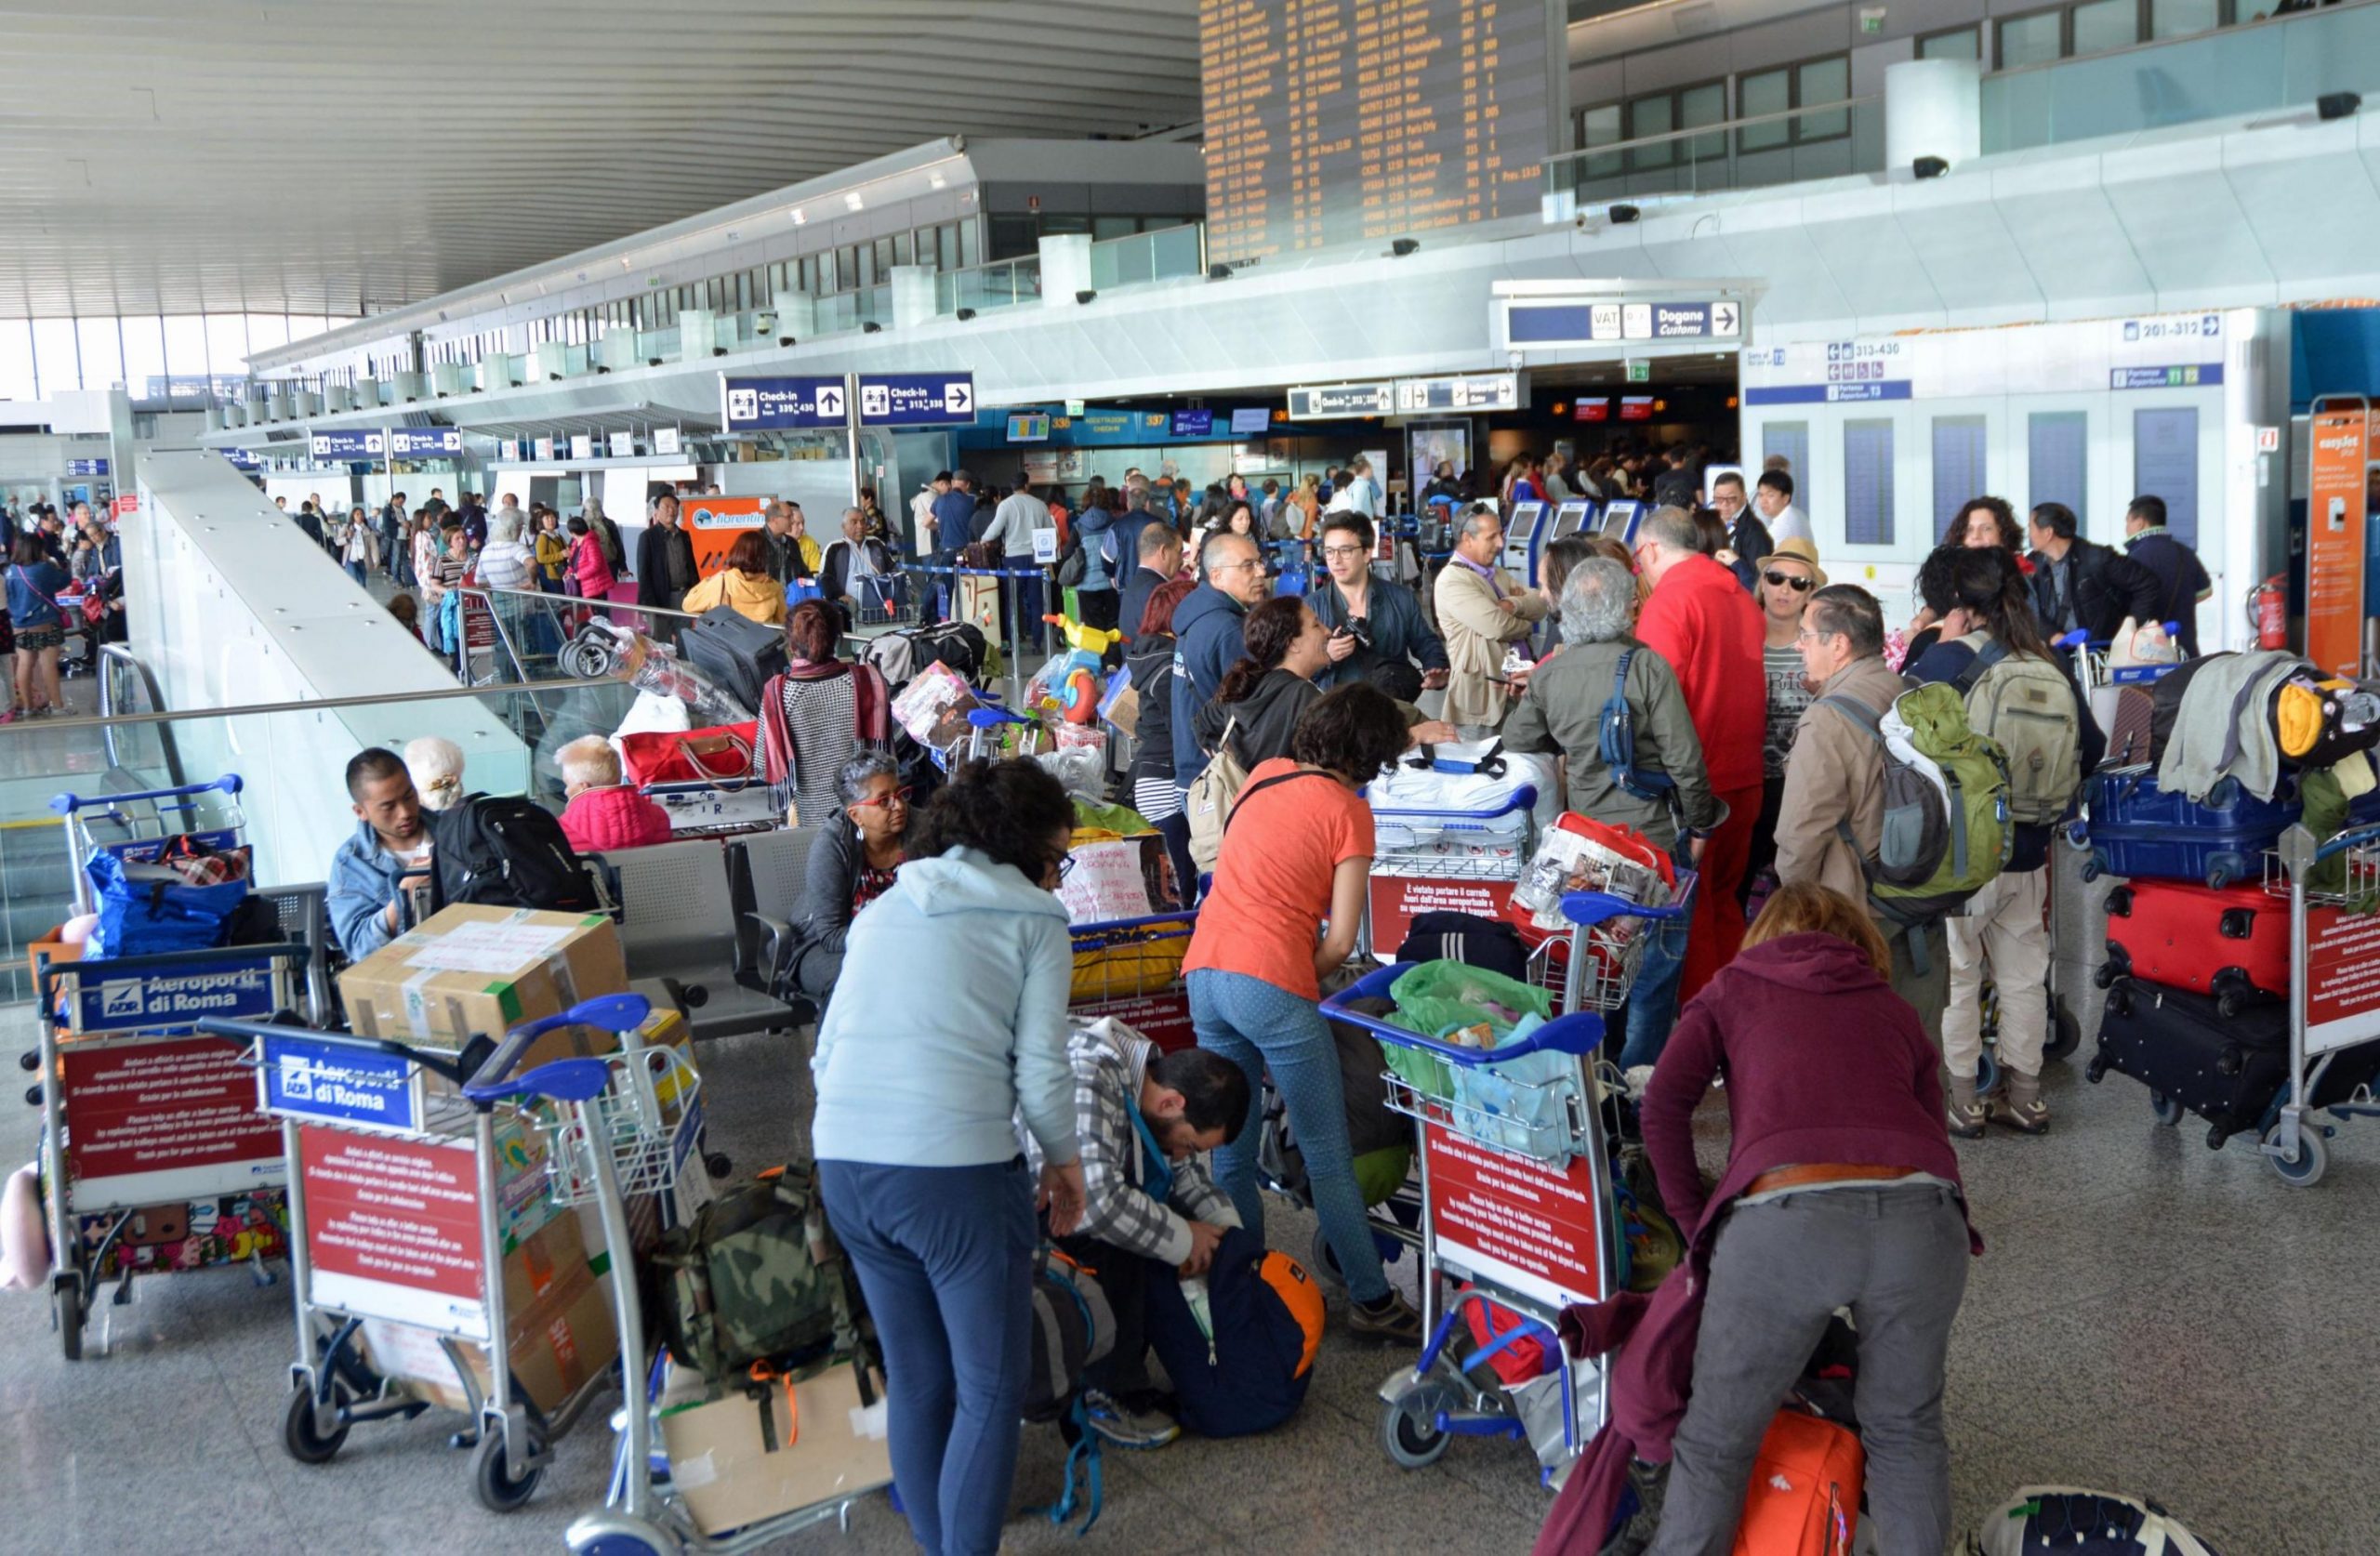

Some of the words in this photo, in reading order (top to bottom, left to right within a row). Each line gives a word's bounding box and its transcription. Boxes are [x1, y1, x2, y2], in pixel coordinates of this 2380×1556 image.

[1594, 312, 1618, 323] VAT
[1659, 309, 1704, 325] Dogane
[1659, 323, 1702, 336] Customs
[2144, 322, 2199, 337] 201-312
[1856, 343, 1900, 357] 313-430
[759, 391, 798, 402] Check-in
[891, 387, 928, 398] Check-in
[800, 402, 815, 412] 430
[2320, 435, 2359, 451] easyJet
[1413, 885, 1435, 894] vietato
[1435, 887, 1459, 897] portare
[1460, 887, 1464, 895] il
[1465, 888, 1490, 898] carrello
[1404, 894, 1419, 903] fuori
[1420, 895, 1447, 905] dall'area
[1448, 898, 1488, 908] aeroportuale
[147, 969, 256, 995] Aeroporti
[149, 996, 170, 1014] di
[174, 992, 237, 1012] Roma
[314, 1060, 400, 1090] Aeroporti
[315, 1083, 333, 1104] di
[334, 1084, 385, 1112] Roma
